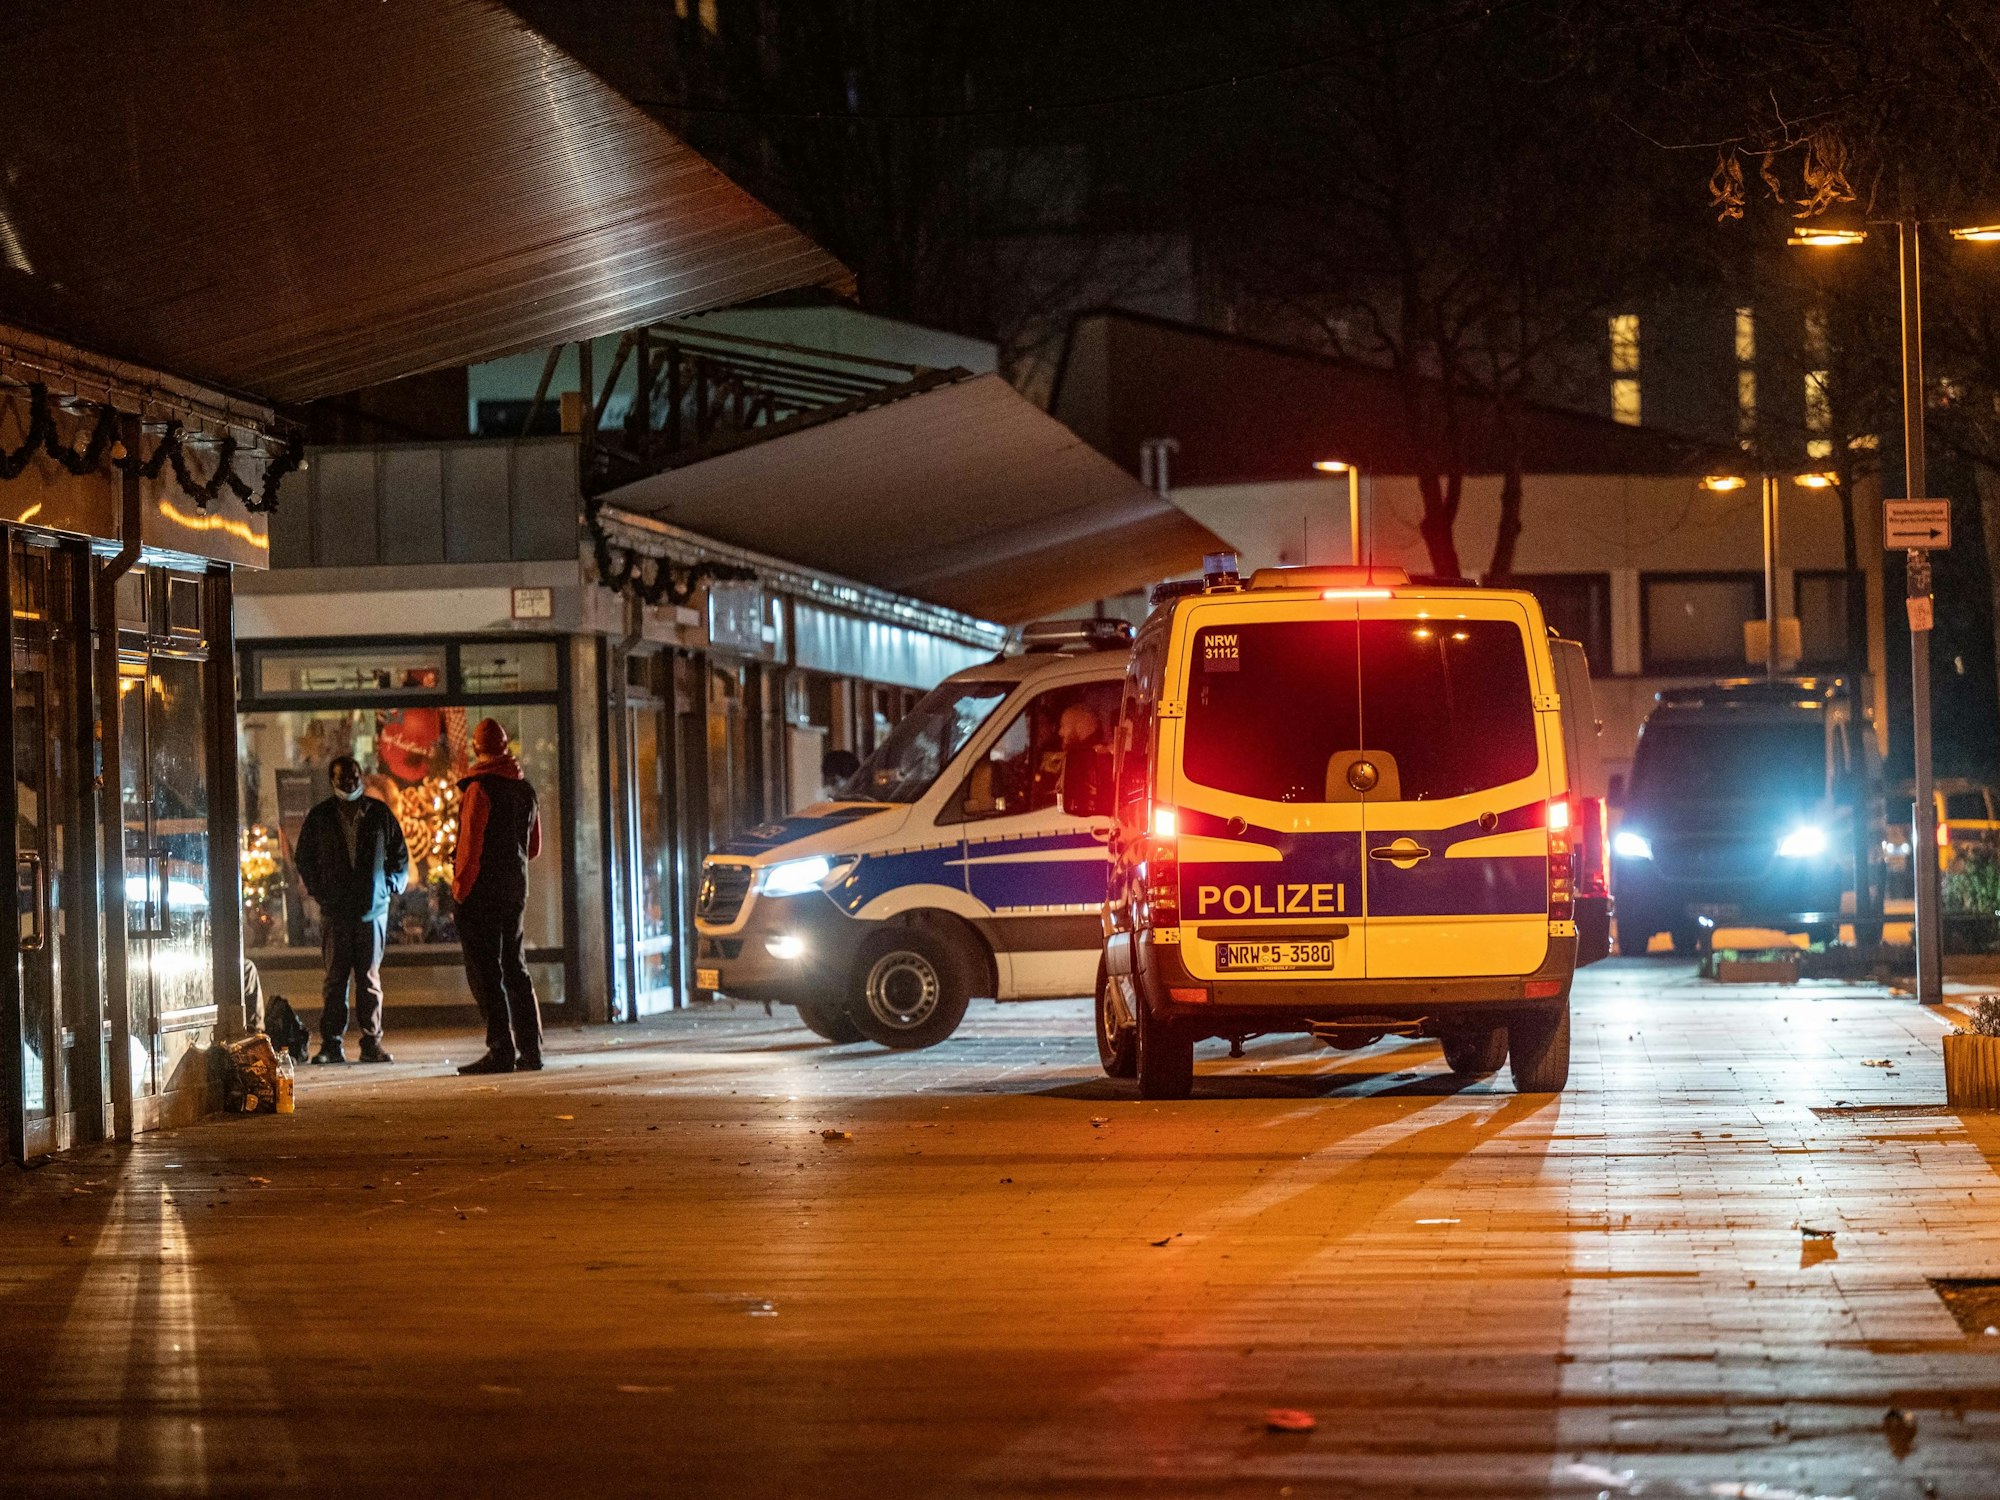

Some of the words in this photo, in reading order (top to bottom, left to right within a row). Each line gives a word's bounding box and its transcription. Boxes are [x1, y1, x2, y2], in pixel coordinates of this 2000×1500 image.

[1204, 634, 1238, 647] NRW
[1205, 647, 1239, 659] 31112
[1198, 883, 1345, 915] POLIZEI
[1229, 946, 1260, 964] NRW
[1271, 945, 1331, 963] 5-3580
